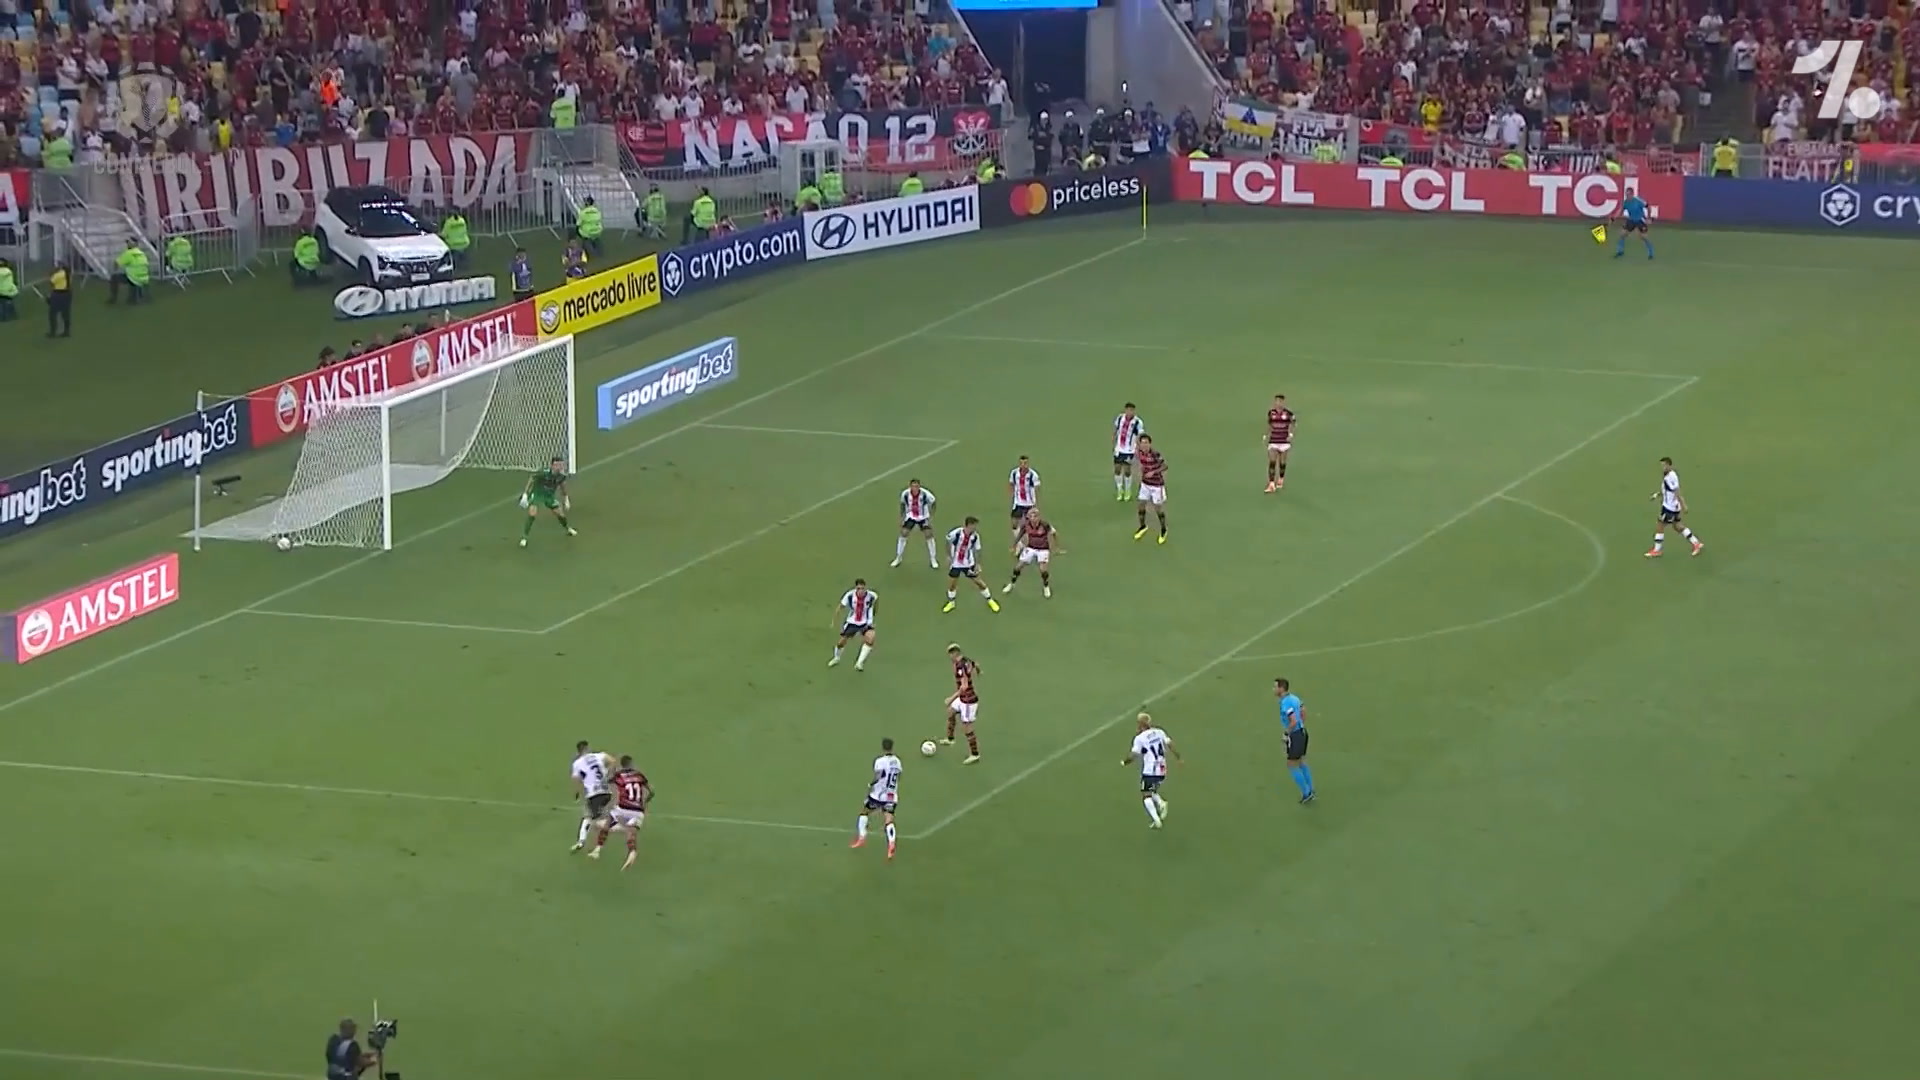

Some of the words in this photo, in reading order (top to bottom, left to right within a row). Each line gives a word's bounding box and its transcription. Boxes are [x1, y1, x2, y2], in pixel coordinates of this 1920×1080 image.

[885, 115, 937, 164] 12
[1052, 175, 1140, 210] priceless
[1189, 160, 1315, 205] TCL
[1357, 167, 1485, 212] TCL
[863, 195, 974, 240] HYUNDAI
[689, 227, 801, 281] crypto.com
[384, 276, 496, 313] HYUNDAI
[563, 279, 626, 323] mercado
[627, 271, 657, 304] livre
[437, 313, 518, 376] AMSTEL
[303, 353, 394, 425] AMSTEL
[615, 343, 734, 419] sportingbet
[101, 403, 237, 491] sportingbet
[57, 562, 176, 644] AMSTEL
[590, 764, 604, 780] 3
[1150, 742, 1165, 761] 14
[625, 782, 642, 801] 11
